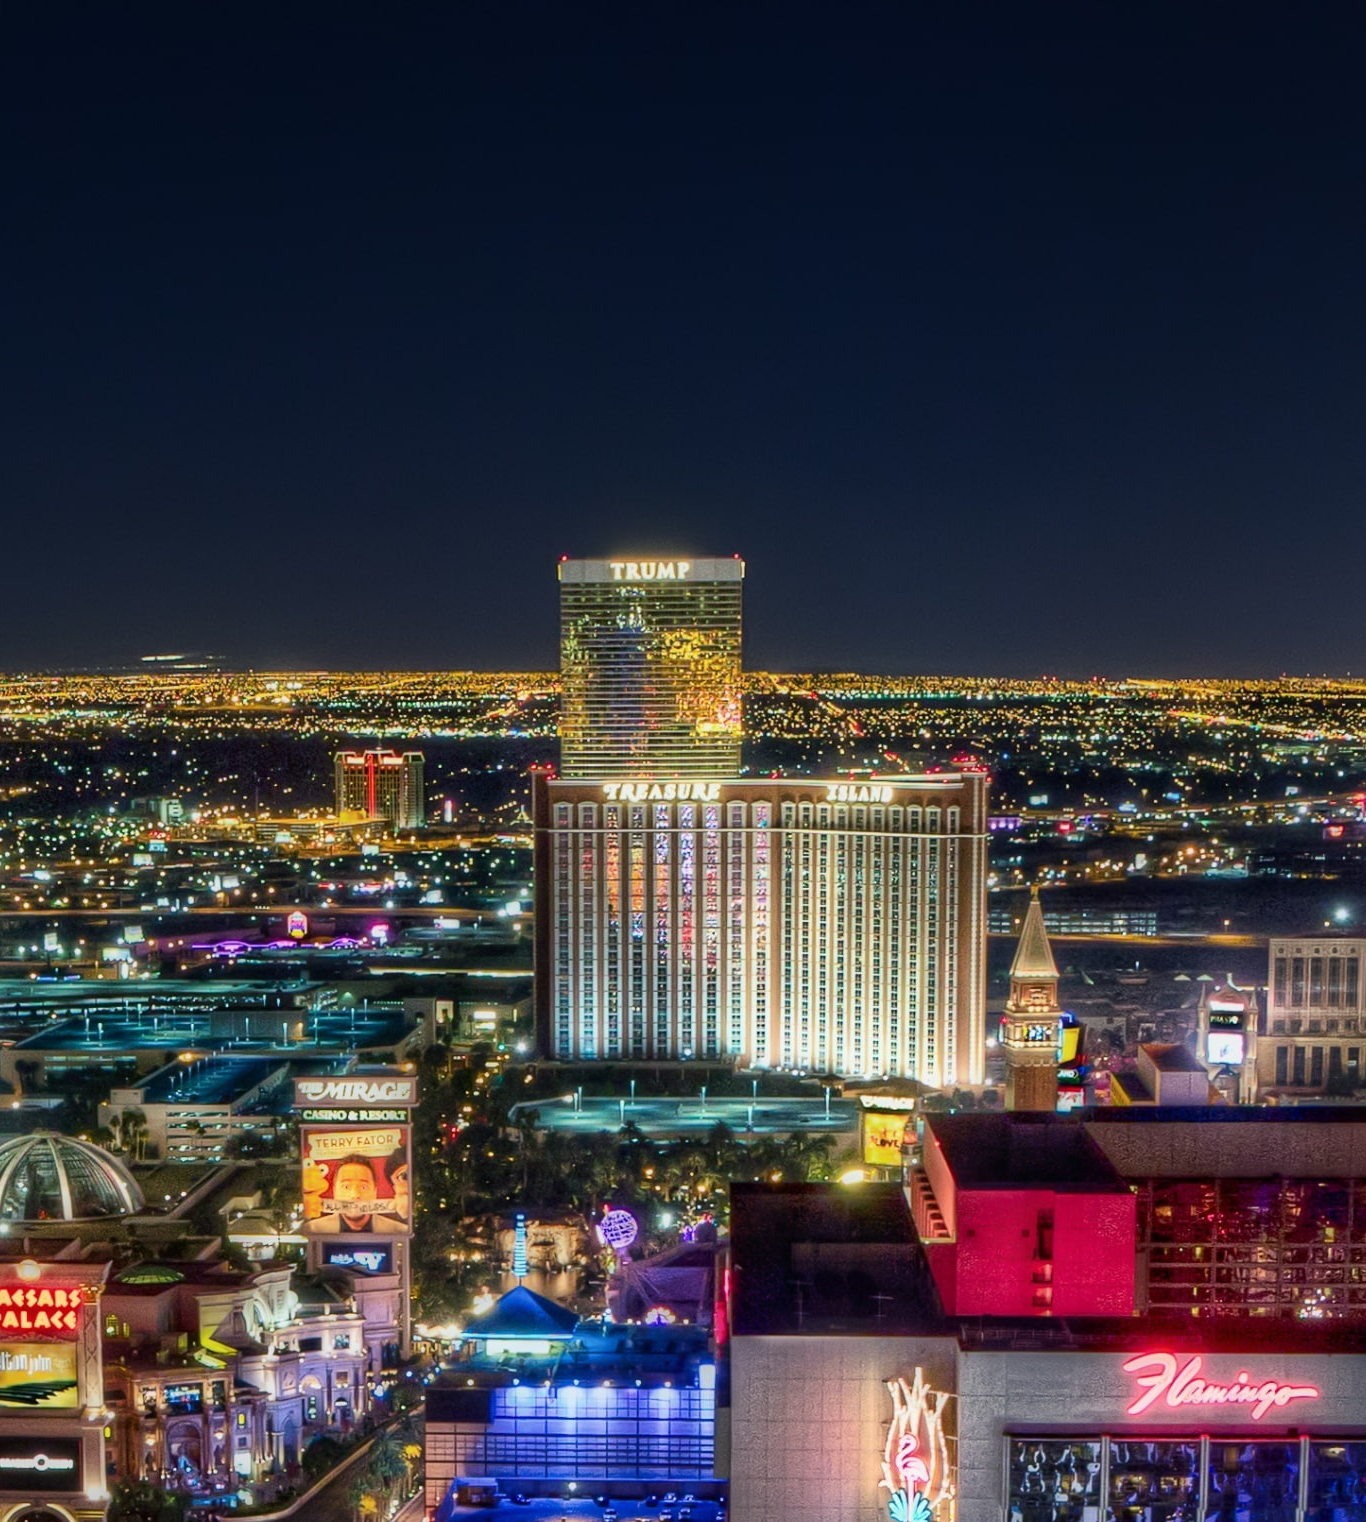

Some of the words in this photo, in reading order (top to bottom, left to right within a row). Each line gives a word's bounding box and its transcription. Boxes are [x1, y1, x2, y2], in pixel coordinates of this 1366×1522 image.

[610, 562, 690, 580] TRUMP
[603, 784, 722, 800] TREASURE
[827, 785, 894, 802] ISLAND
[308, 1081, 411, 1102] MIRAGE
[302, 1109, 347, 1120] CASINO
[348, 1109, 358, 1120] &
[359, 1109, 407, 1120] RESORT
[316, 1137, 353, 1149] TERRY
[357, 1134, 394, 1146] FATOR
[28, 1354, 52, 1375] john
[1123, 1352, 1319, 1420] Flamingo
